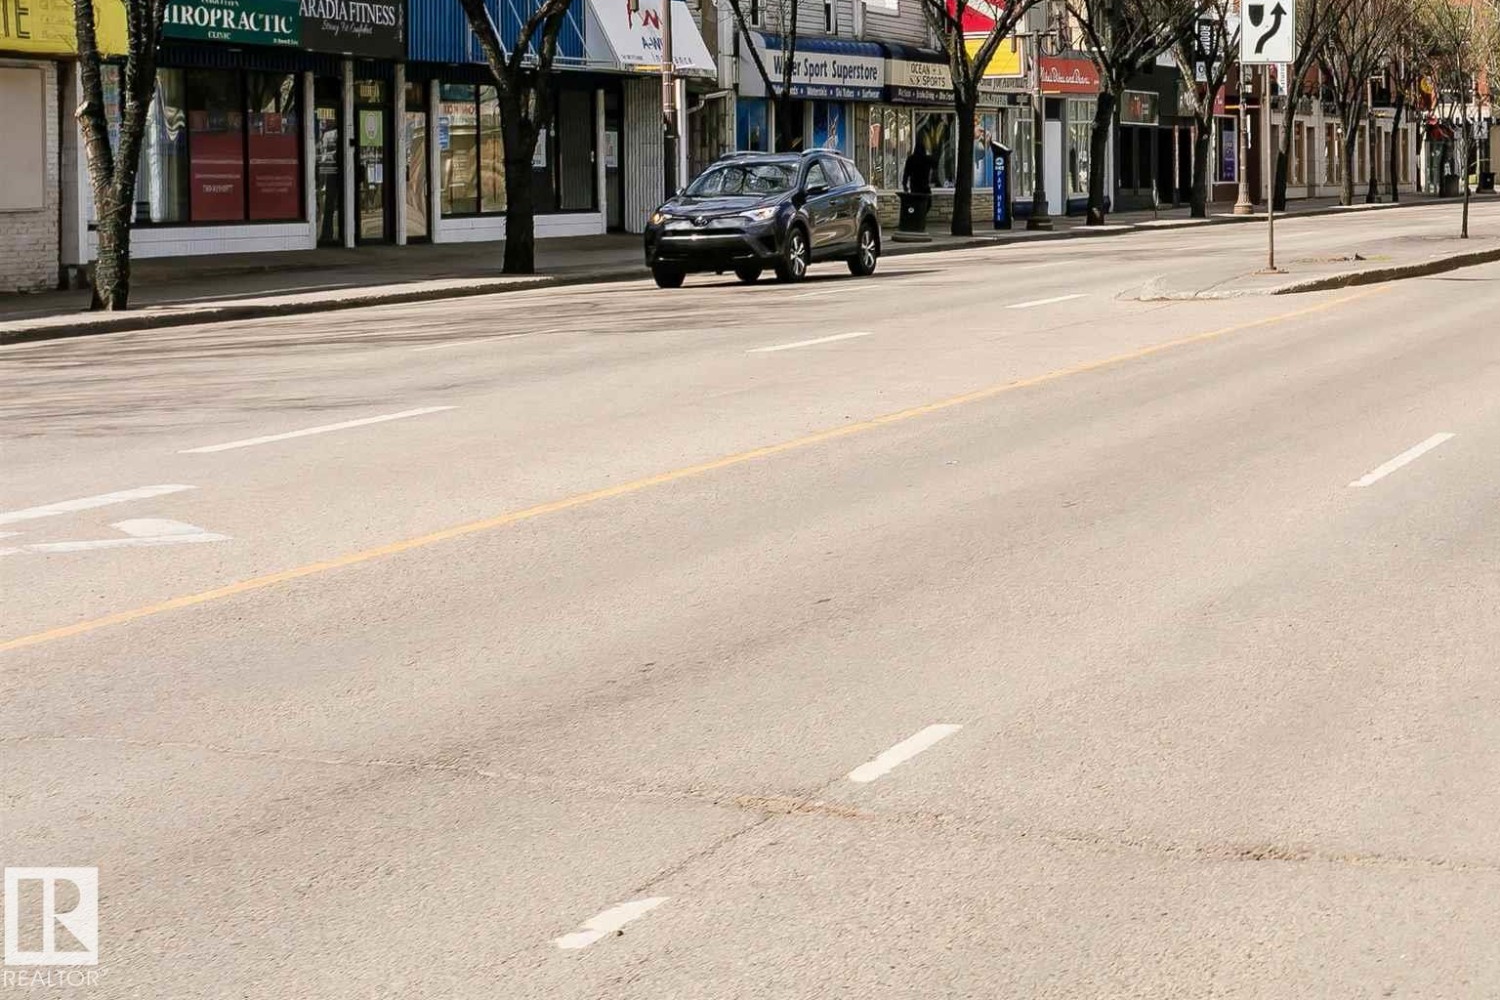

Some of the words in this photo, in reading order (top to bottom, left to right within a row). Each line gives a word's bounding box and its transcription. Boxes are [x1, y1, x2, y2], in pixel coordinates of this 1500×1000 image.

[163, 4, 294, 34] IROPRACTIC
[348, 1, 396, 26] FITNESS
[773, 56, 801, 76] Wer
[804, 58, 828, 84] Sport
[832, 60, 878, 84] Superstore
[910, 63, 931, 76] OCEAN
[922, 75, 946, 88] SPORTS
